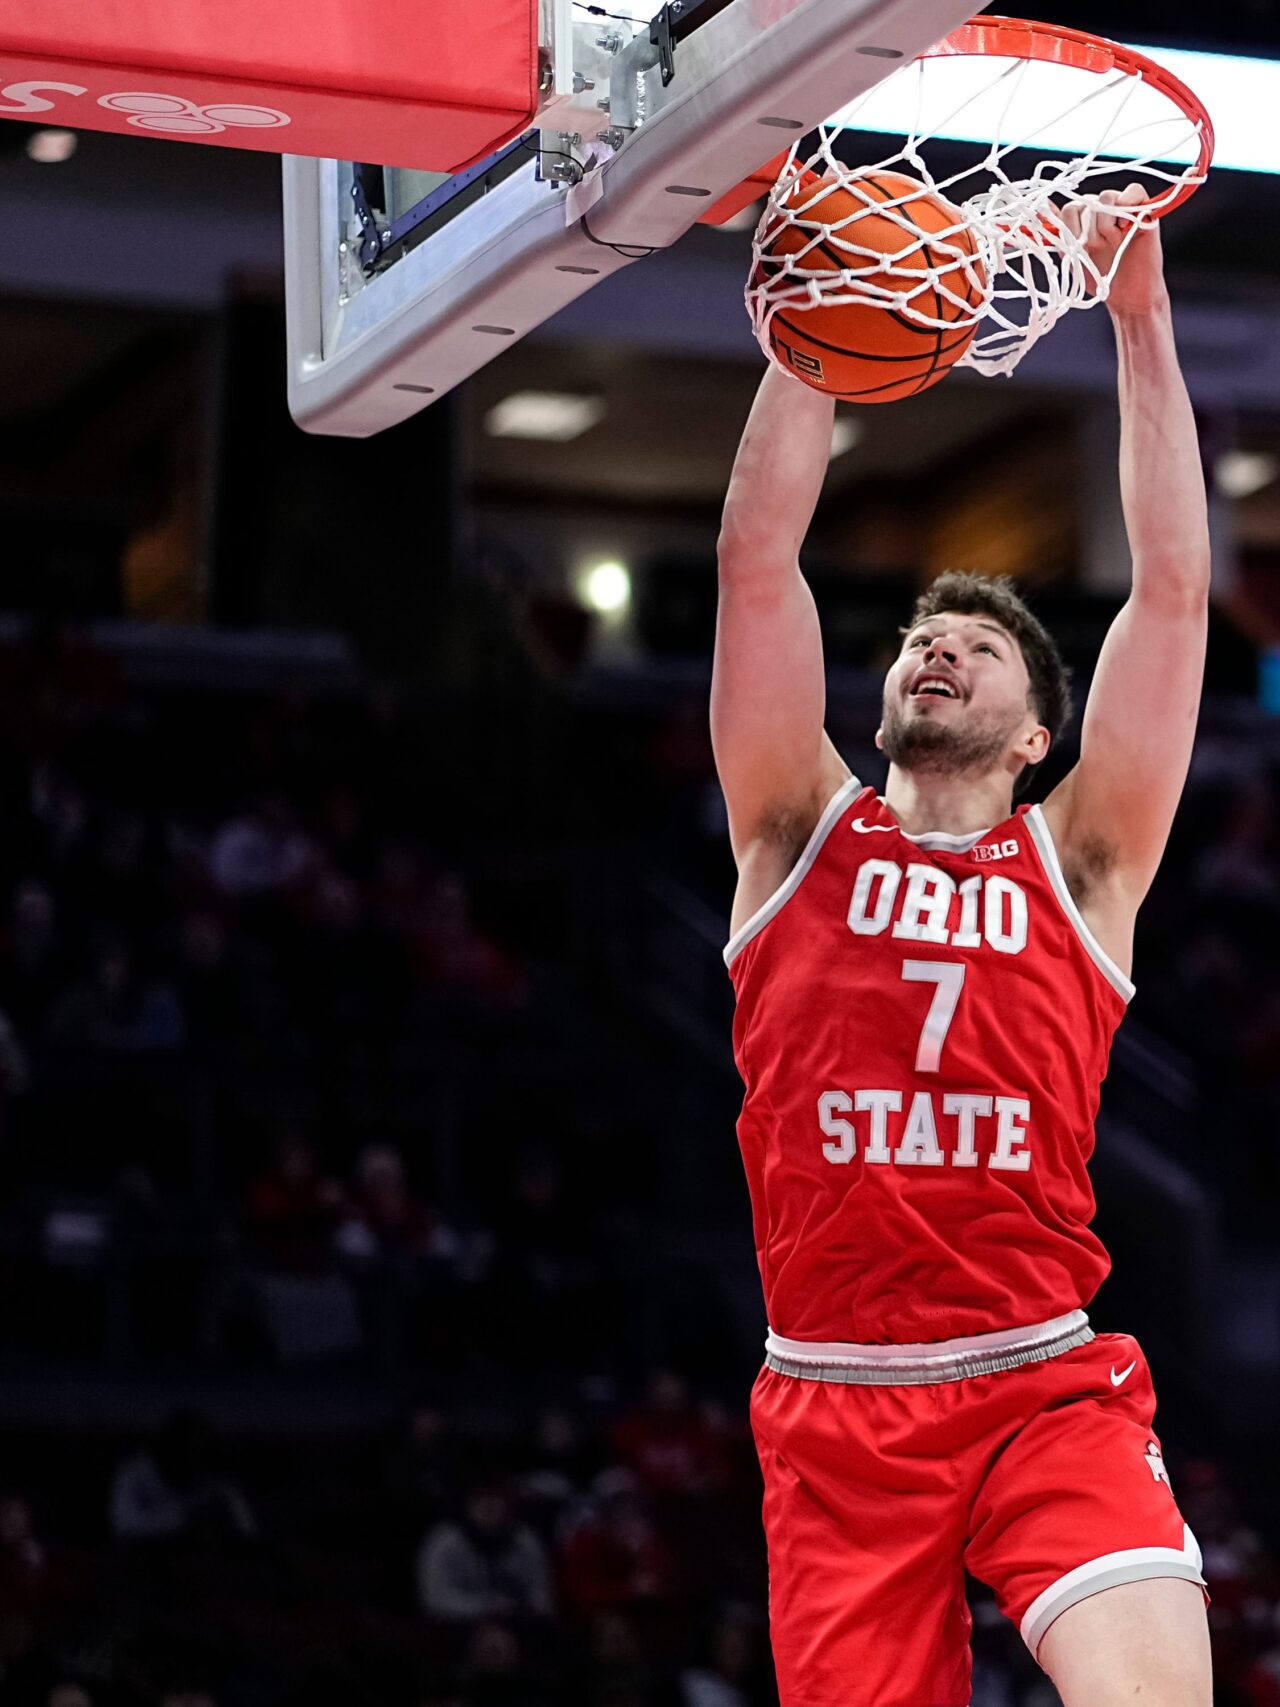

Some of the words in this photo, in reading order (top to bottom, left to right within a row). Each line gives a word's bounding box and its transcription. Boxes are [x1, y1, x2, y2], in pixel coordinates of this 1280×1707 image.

[846, 858, 1029, 955] OHIO
[901, 959, 966, 1073] 7
[817, 1089, 1032, 1172] STATE
